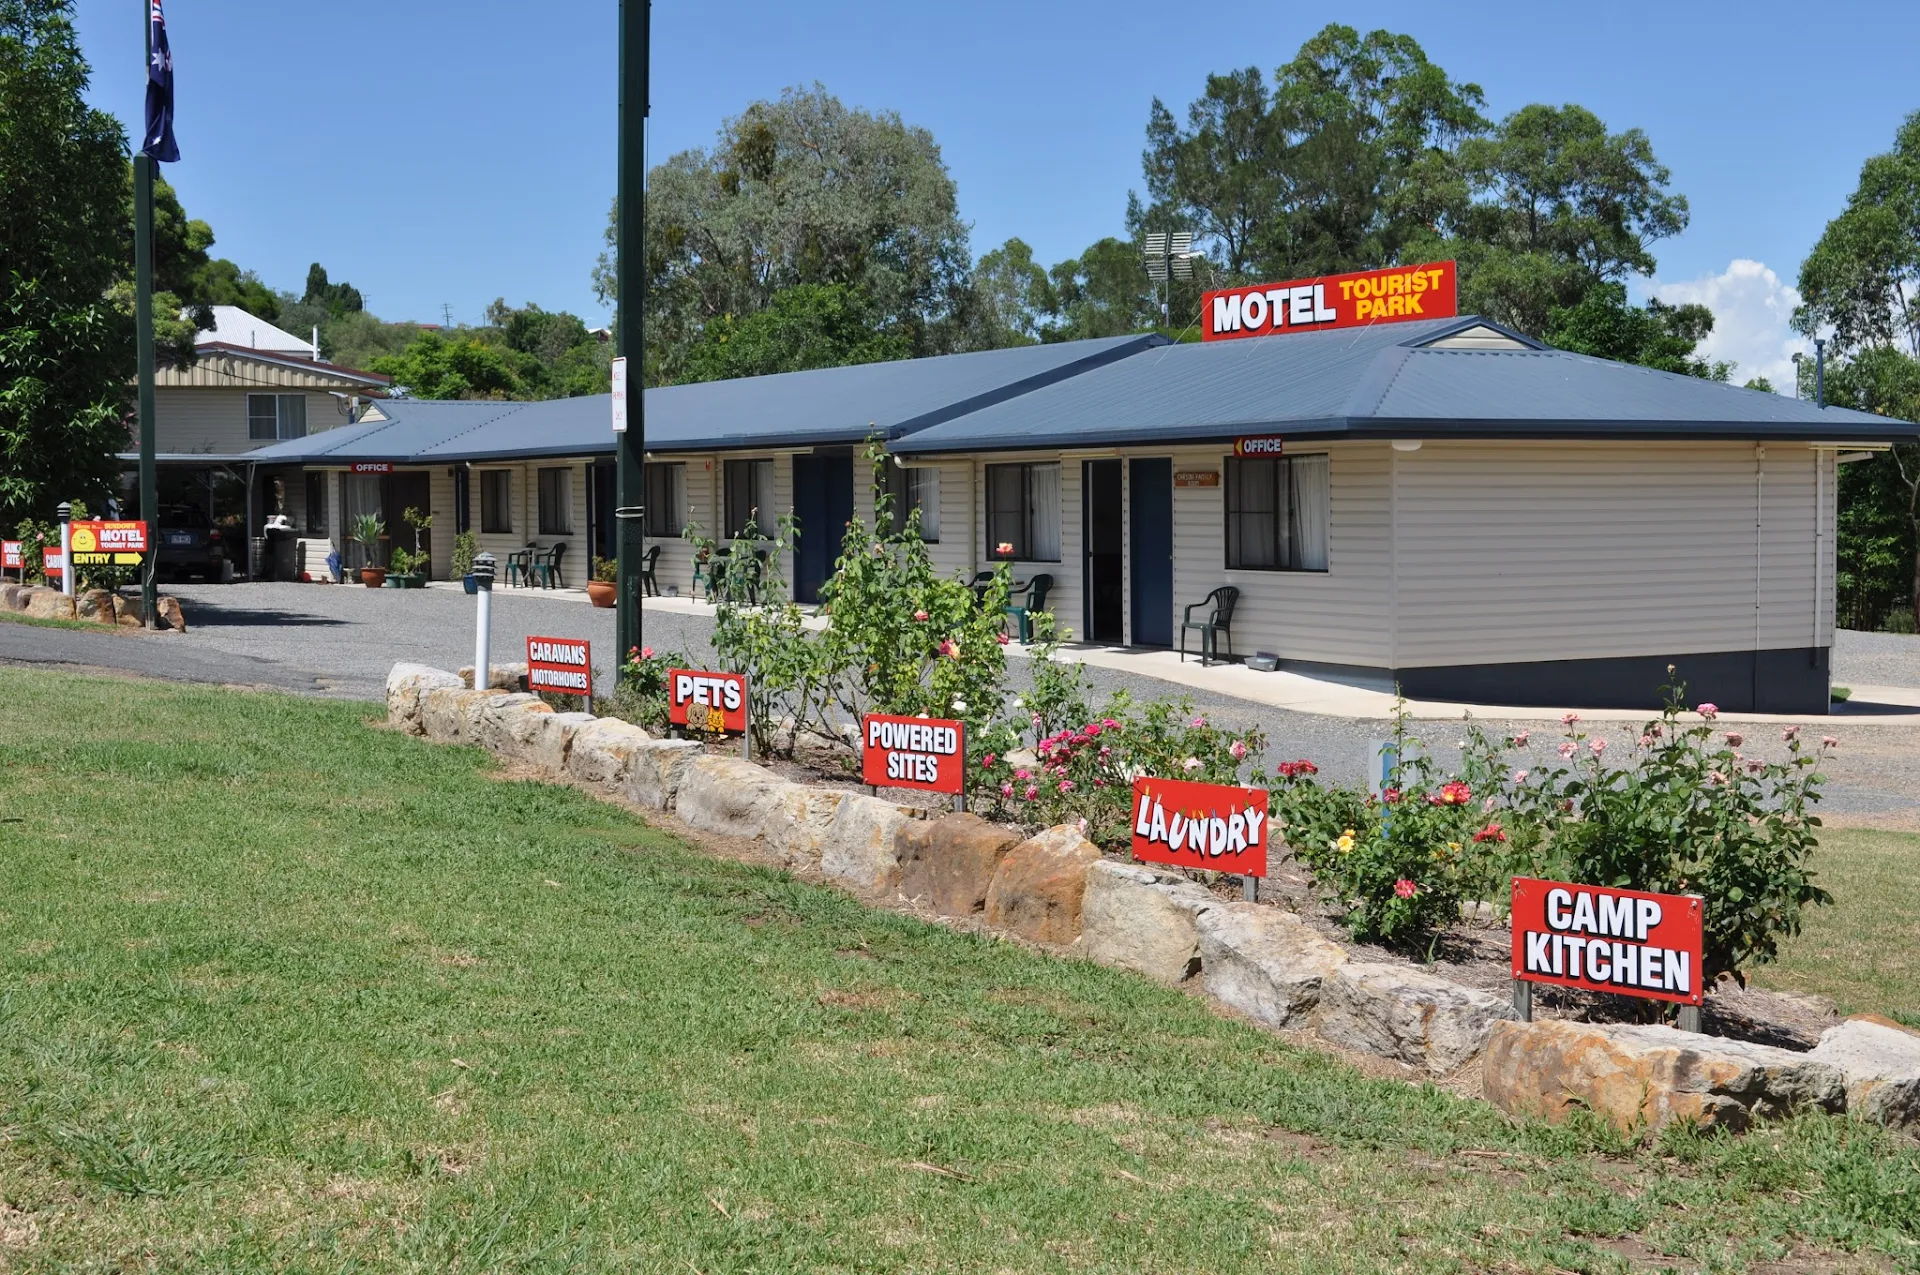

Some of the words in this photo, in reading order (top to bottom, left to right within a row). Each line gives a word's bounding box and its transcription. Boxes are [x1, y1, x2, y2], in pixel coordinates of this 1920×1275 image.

[1339, 269, 1444, 300] TOURIST
[1213, 284, 1336, 333] MOTEL
[1356, 293, 1424, 320] PARK
[1244, 438, 1281, 453] OFFICE
[356, 463, 388, 472] OFFICE
[100, 529, 144, 541] MOTEL
[73, 553, 111, 564] ENTRY
[530, 641, 586, 666] CARAVANS
[531, 668, 587, 689] MOTORHOMES
[676, 674, 741, 711] PETS
[868, 721, 957, 755] POWERED
[887, 751, 938, 783] SITES
[1135, 794, 1265, 859] LAUNDRY
[1546, 887, 1663, 942] CAMP
[1525, 930, 1692, 995] KITCHEN
